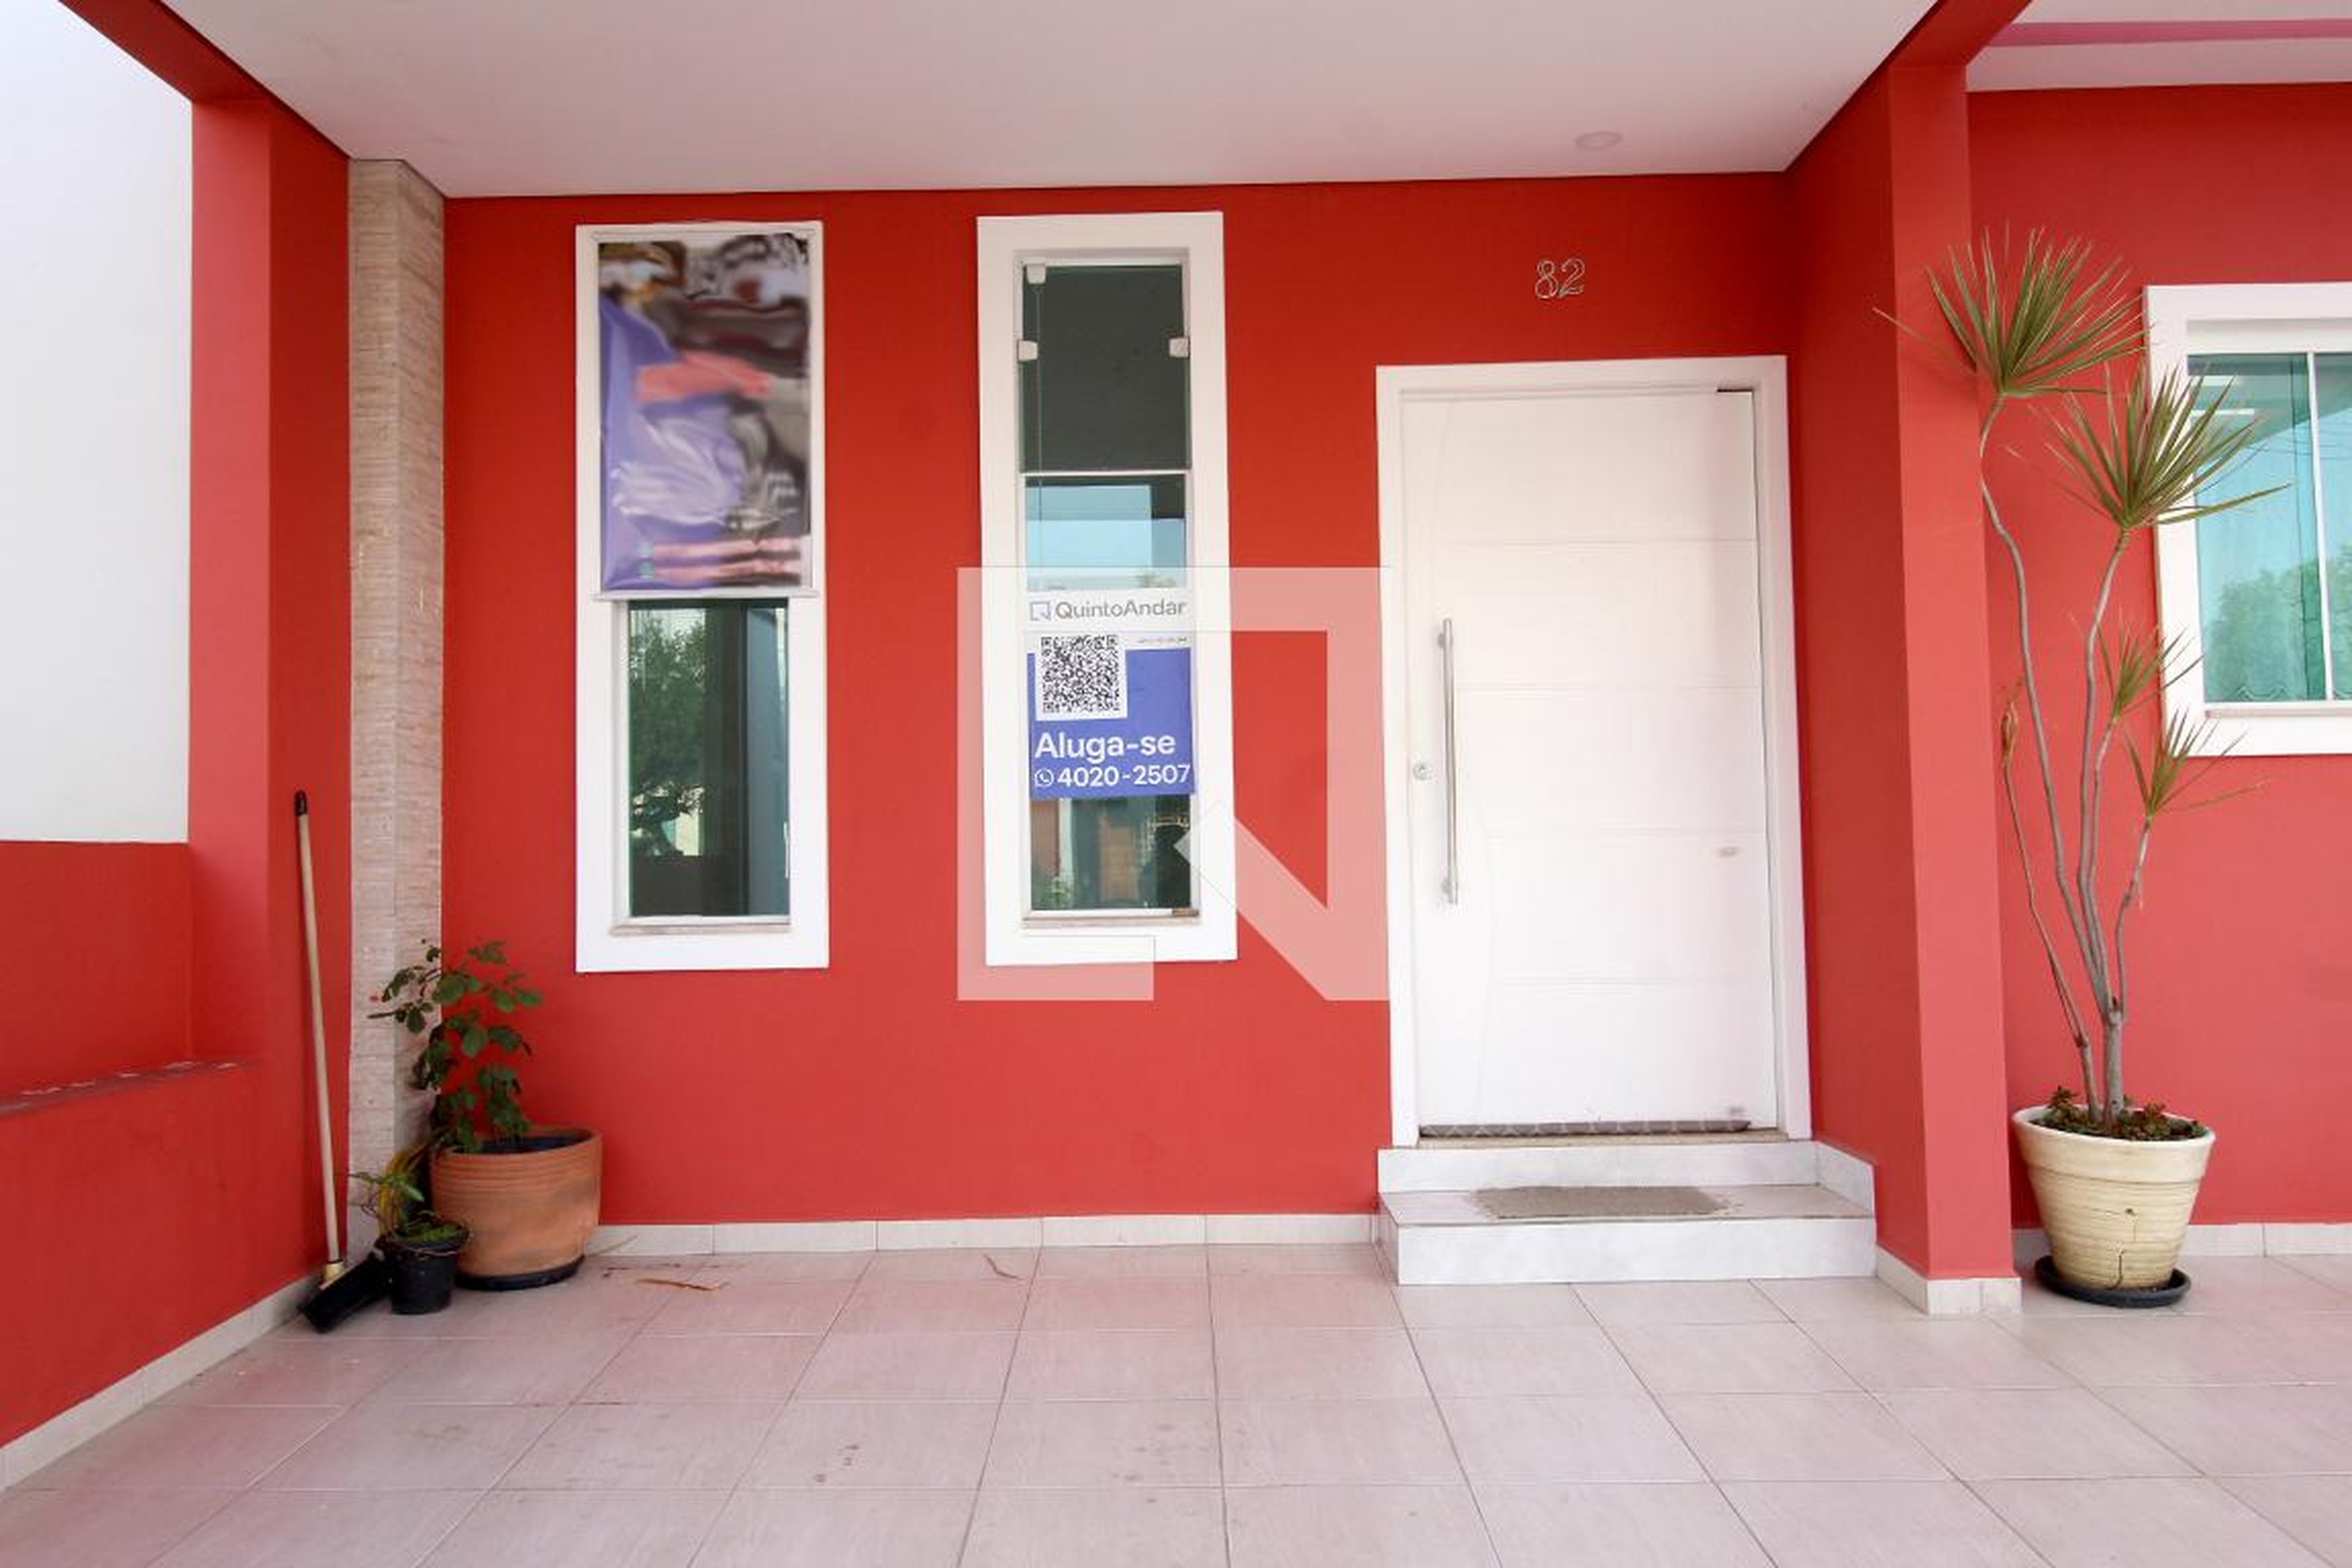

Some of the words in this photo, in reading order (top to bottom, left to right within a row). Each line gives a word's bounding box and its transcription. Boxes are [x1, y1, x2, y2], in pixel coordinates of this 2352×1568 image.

[1534, 258, 1585, 298] 82
[1055, 599, 1187, 619] QuintoAndar
[1035, 732, 1177, 764] Aluga-se
[1057, 764, 1191, 787] 4020-2507
